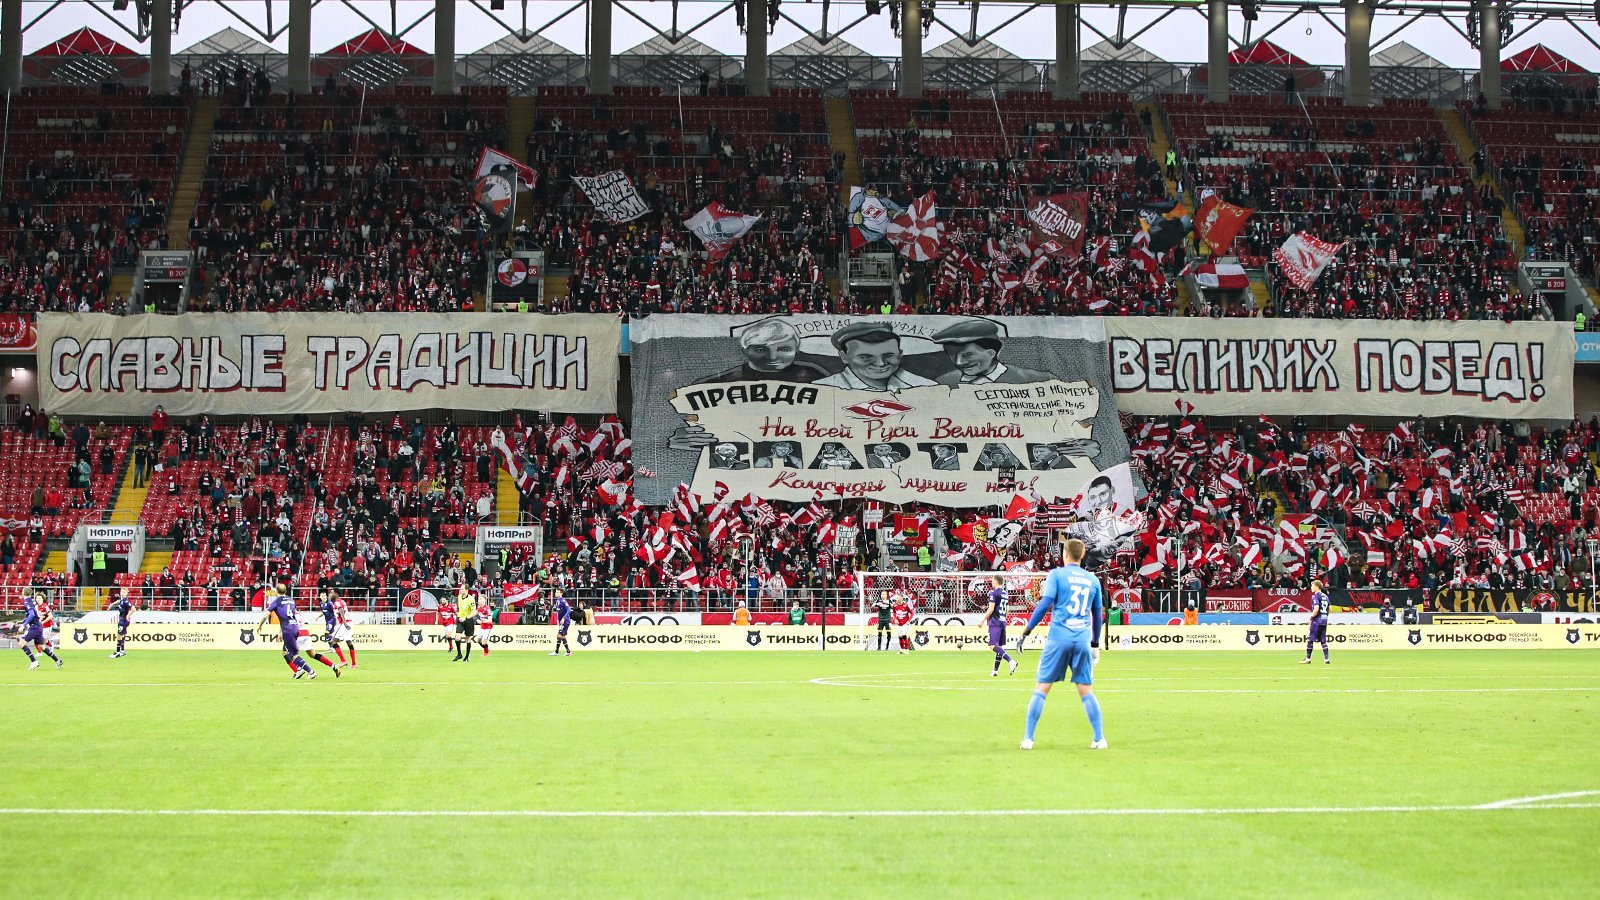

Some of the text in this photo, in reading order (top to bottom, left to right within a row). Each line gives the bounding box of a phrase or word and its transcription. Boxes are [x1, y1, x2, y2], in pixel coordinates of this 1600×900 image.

[51, 332, 588, 393] СЛАВНЫЕ ТРАДИЦИИ
[1110, 337, 1546, 402] ВЕЛИКИХ ПОБЕД!
[685, 383, 818, 410] ПРАВДА
[974, 389, 1030, 401] СЕГОДНЯ
[987, 400, 1062, 411] ПОСТАНОВЛЕНИЕ
[759, 416, 796, 437] На
[863, 418, 919, 442] Руси
[929, 417, 1025, 440] Великой
[768, 471, 887, 497] Команды
[900, 477, 968, 493] лучше
[487, 530, 532, 538] НФПРиР
[1066, 585, 1090, 616] 31
[1206, 600, 1251, 611] ТУЬСКИЕ
[597, 635, 682, 644] ТИНЬКОФФ
[935, 635, 990, 644] ТИНЬКО
[1105, 634, 1184, 644] ИЬКОФФ
[1265, 635, 1347, 643] ТИНЬФФ
[1427, 633, 1507, 642] ТИНЬКОФФ
